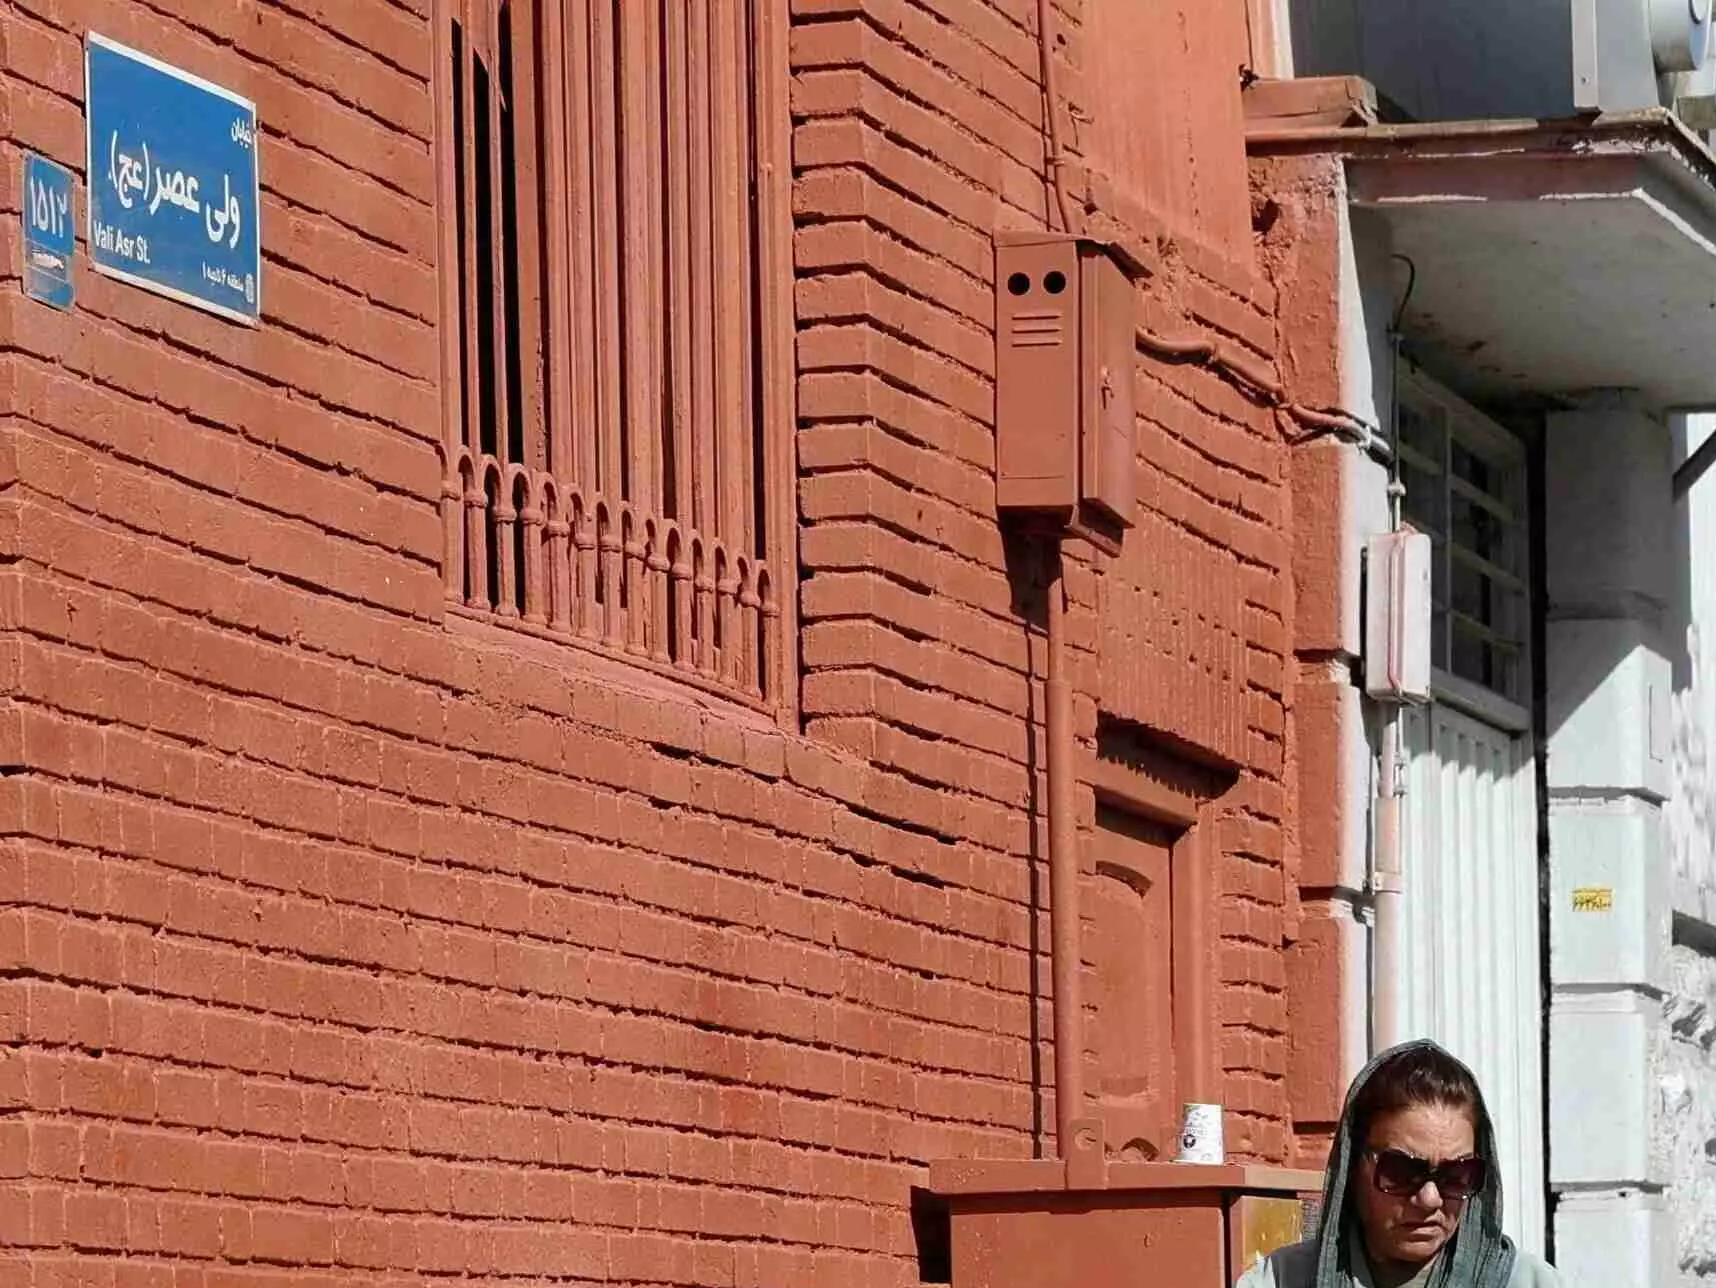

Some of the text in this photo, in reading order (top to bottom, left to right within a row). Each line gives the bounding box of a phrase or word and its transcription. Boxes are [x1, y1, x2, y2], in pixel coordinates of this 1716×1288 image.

[231, 116, 253, 149] خیابان
[30, 175, 68, 239] ۱۵۱۲
[111, 130, 241, 249] ولی عصر (عج)
[93, 220, 151, 264] Vali Asr St.
